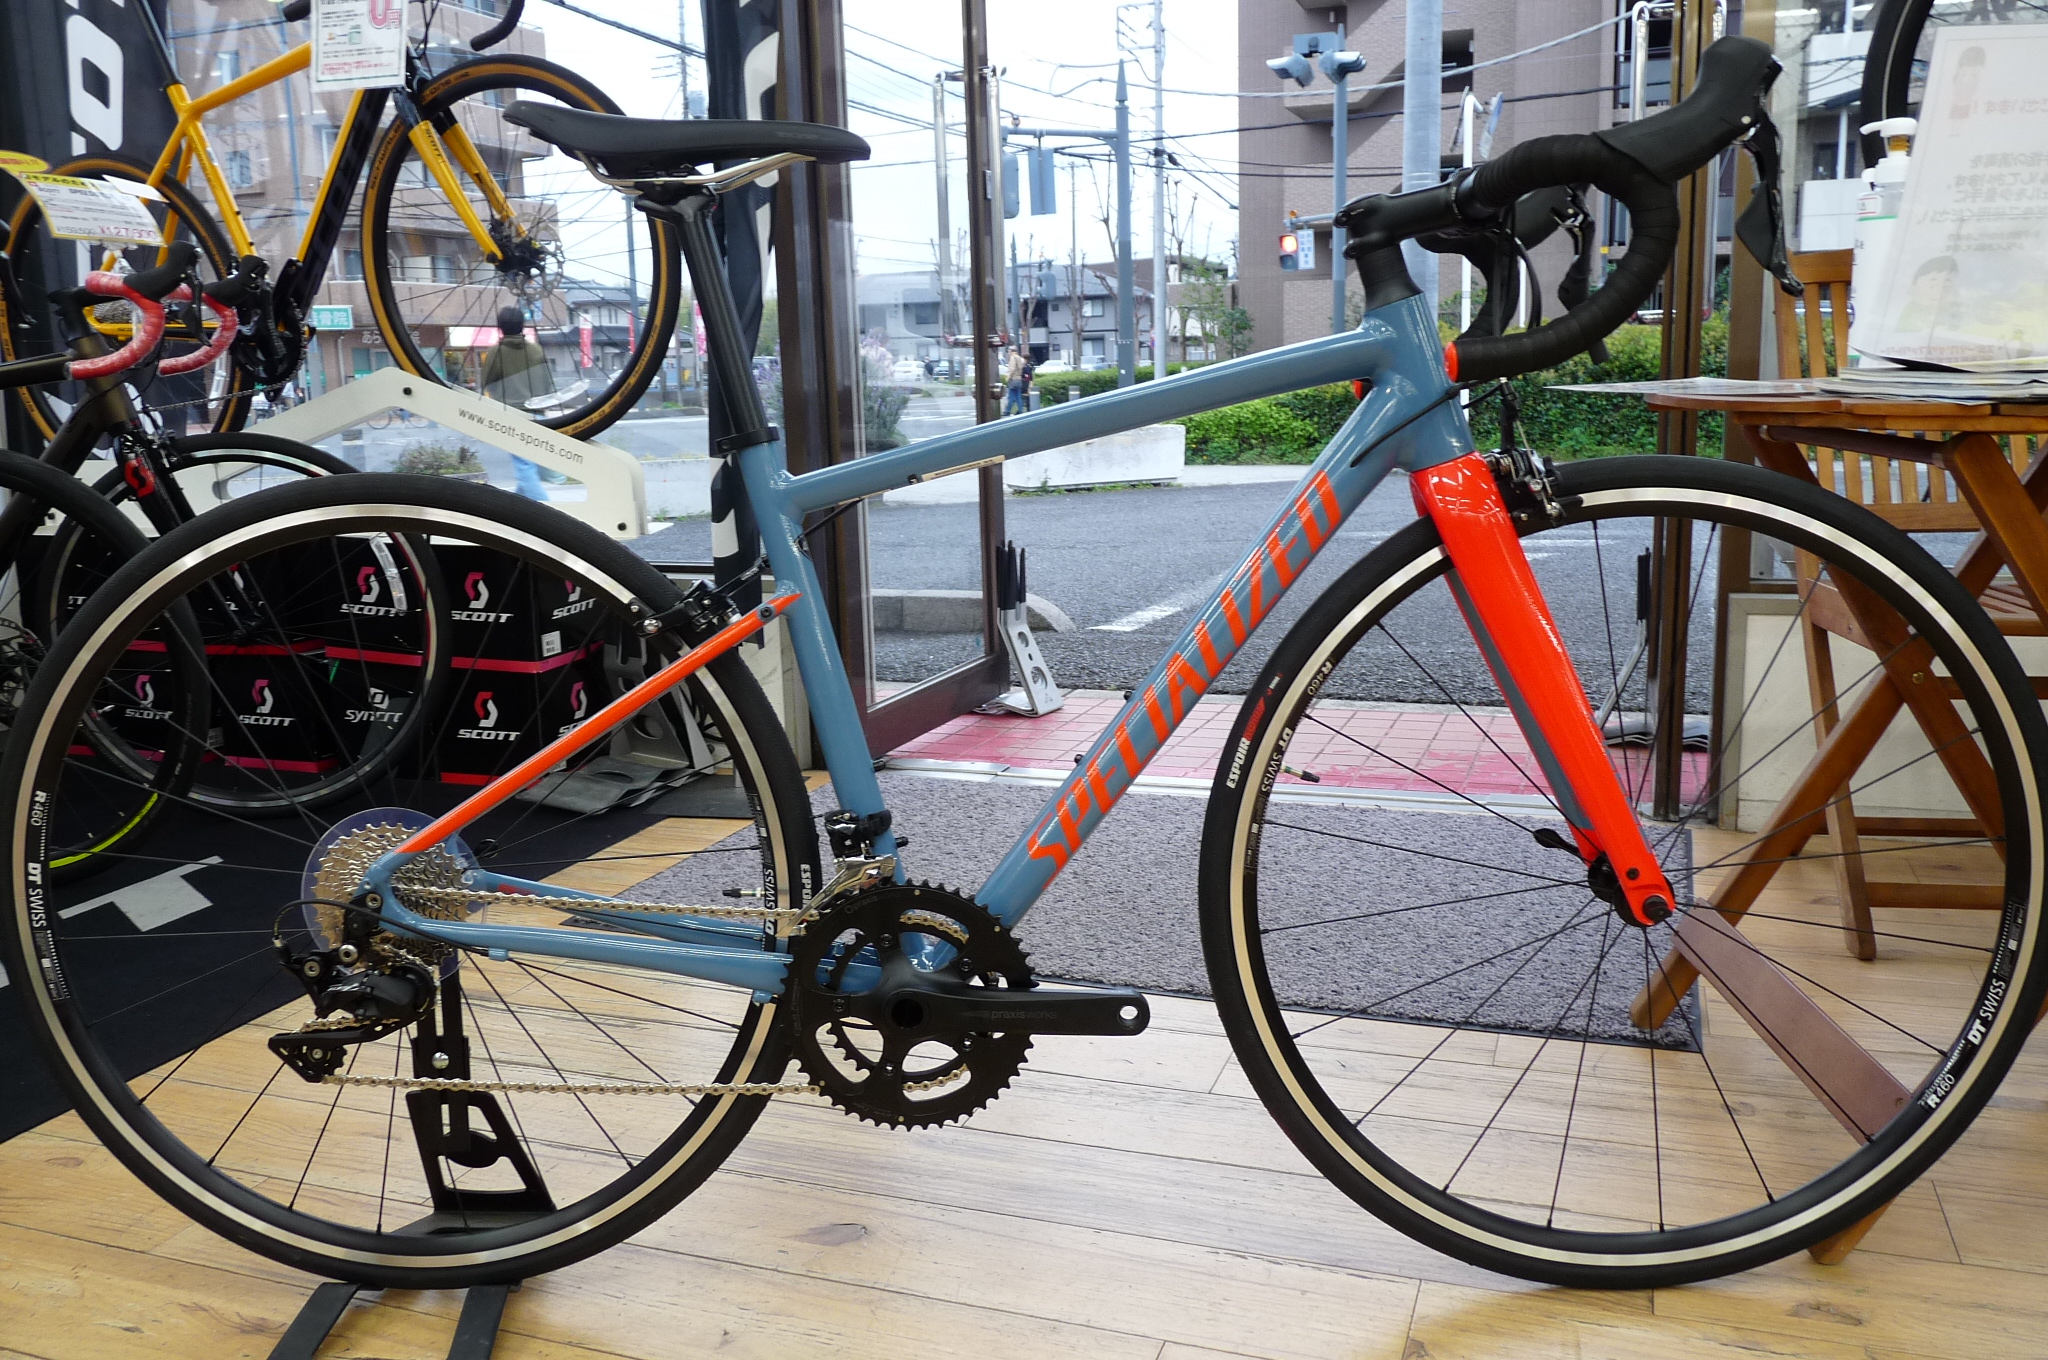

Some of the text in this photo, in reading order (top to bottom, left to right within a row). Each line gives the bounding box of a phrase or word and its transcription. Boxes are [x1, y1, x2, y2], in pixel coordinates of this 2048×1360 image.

[458, 408, 584, 464] www.scott-sports.com
[451, 610, 514, 623] SCOTT
[551, 598, 597, 620] SCOTT
[1027, 468, 1343, 891] SPECIALIZED
[238, 714, 296, 727] SCOTT
[457, 728, 521, 741] SCOTT
[1226, 737, 1251, 790] ESPOIR
[1261, 727, 1293, 793] DT SWISS
[30, 790, 47, 827] R460
[27, 861, 47, 928] DT SWISS
[764, 868, 776, 911] SWISS
[800, 863, 813, 910] ESPOI
[1967, 977, 2006, 1047] DT SWISS
[1926, 1073, 1955, 1109] R460
